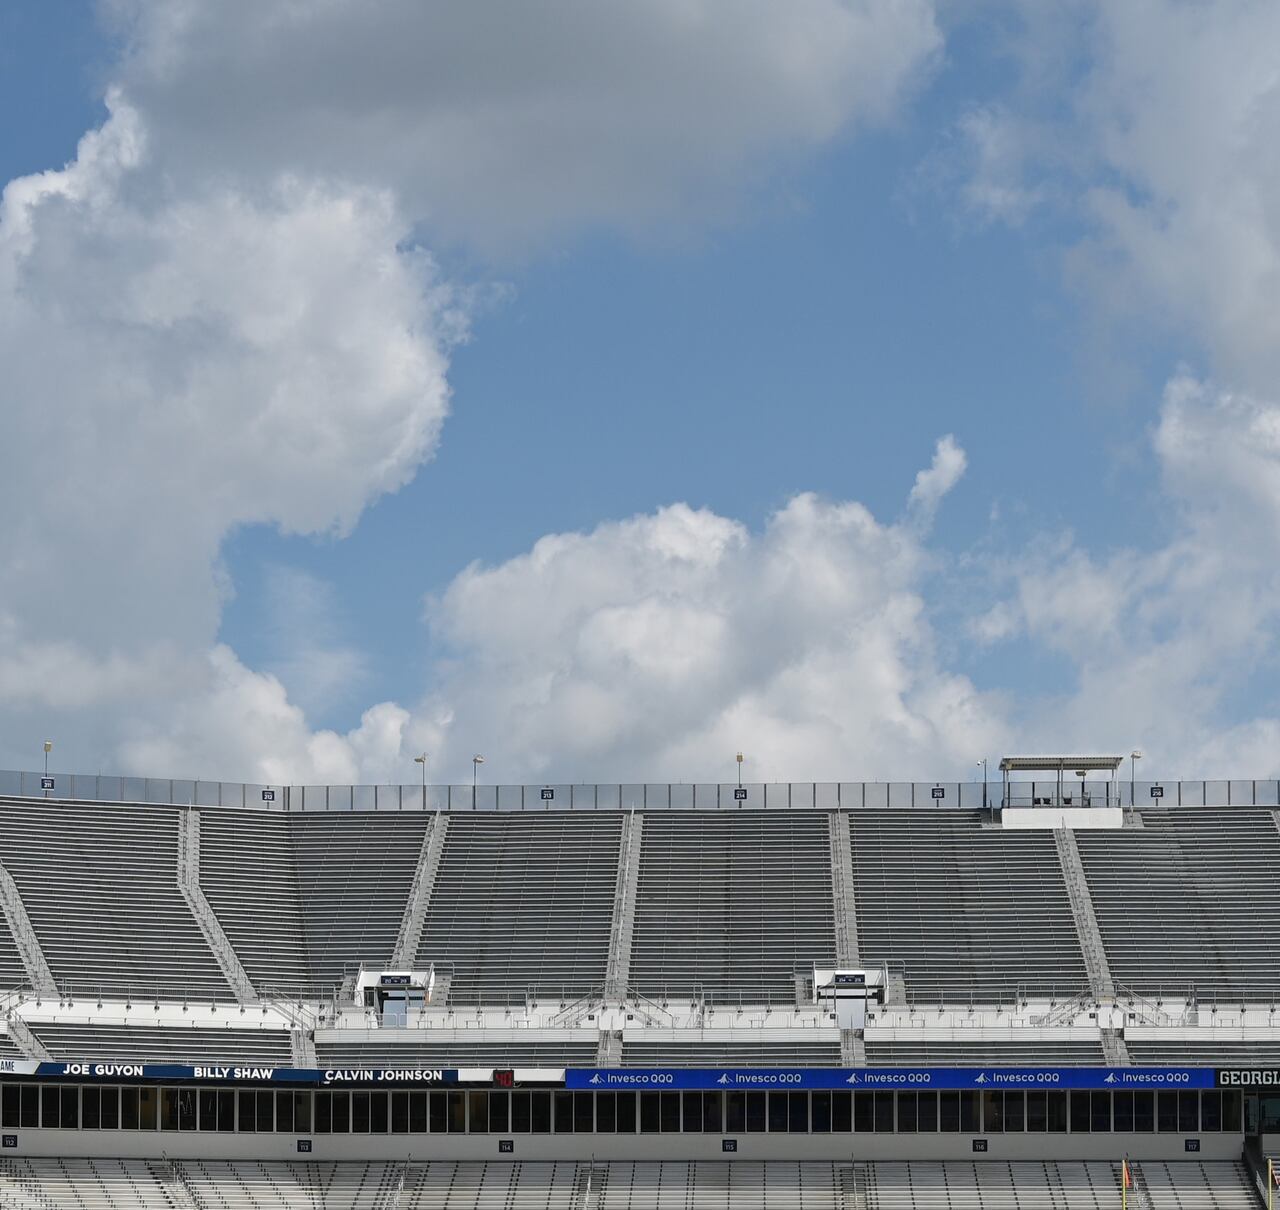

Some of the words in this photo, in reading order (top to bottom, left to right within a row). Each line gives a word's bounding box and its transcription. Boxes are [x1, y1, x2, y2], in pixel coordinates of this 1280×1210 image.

[62, 1064, 90, 1075] JOE
[95, 1065, 143, 1076] GUYON
[194, 1067, 229, 1078] BILLY
[234, 1068, 273, 1079] SHAW
[325, 1070, 373, 1081] CALVIN
[377, 1070, 443, 1081] JOHNSON
[495, 1072, 512, 1088] 40
[607, 1074, 648, 1083] Invesco
[650, 1074, 673, 1084] QQQ
[735, 1074, 776, 1083] Invesco
[779, 1074, 801, 1084] QQQ
[864, 1073, 906, 1082] Invesco
[908, 1073, 931, 1083] QQQ
[993, 1073, 1035, 1082] Invesco
[1037, 1073, 1059, 1083] QQQ
[1122, 1073, 1164, 1082] Invesco
[1166, 1073, 1189, 1083] QQQ
